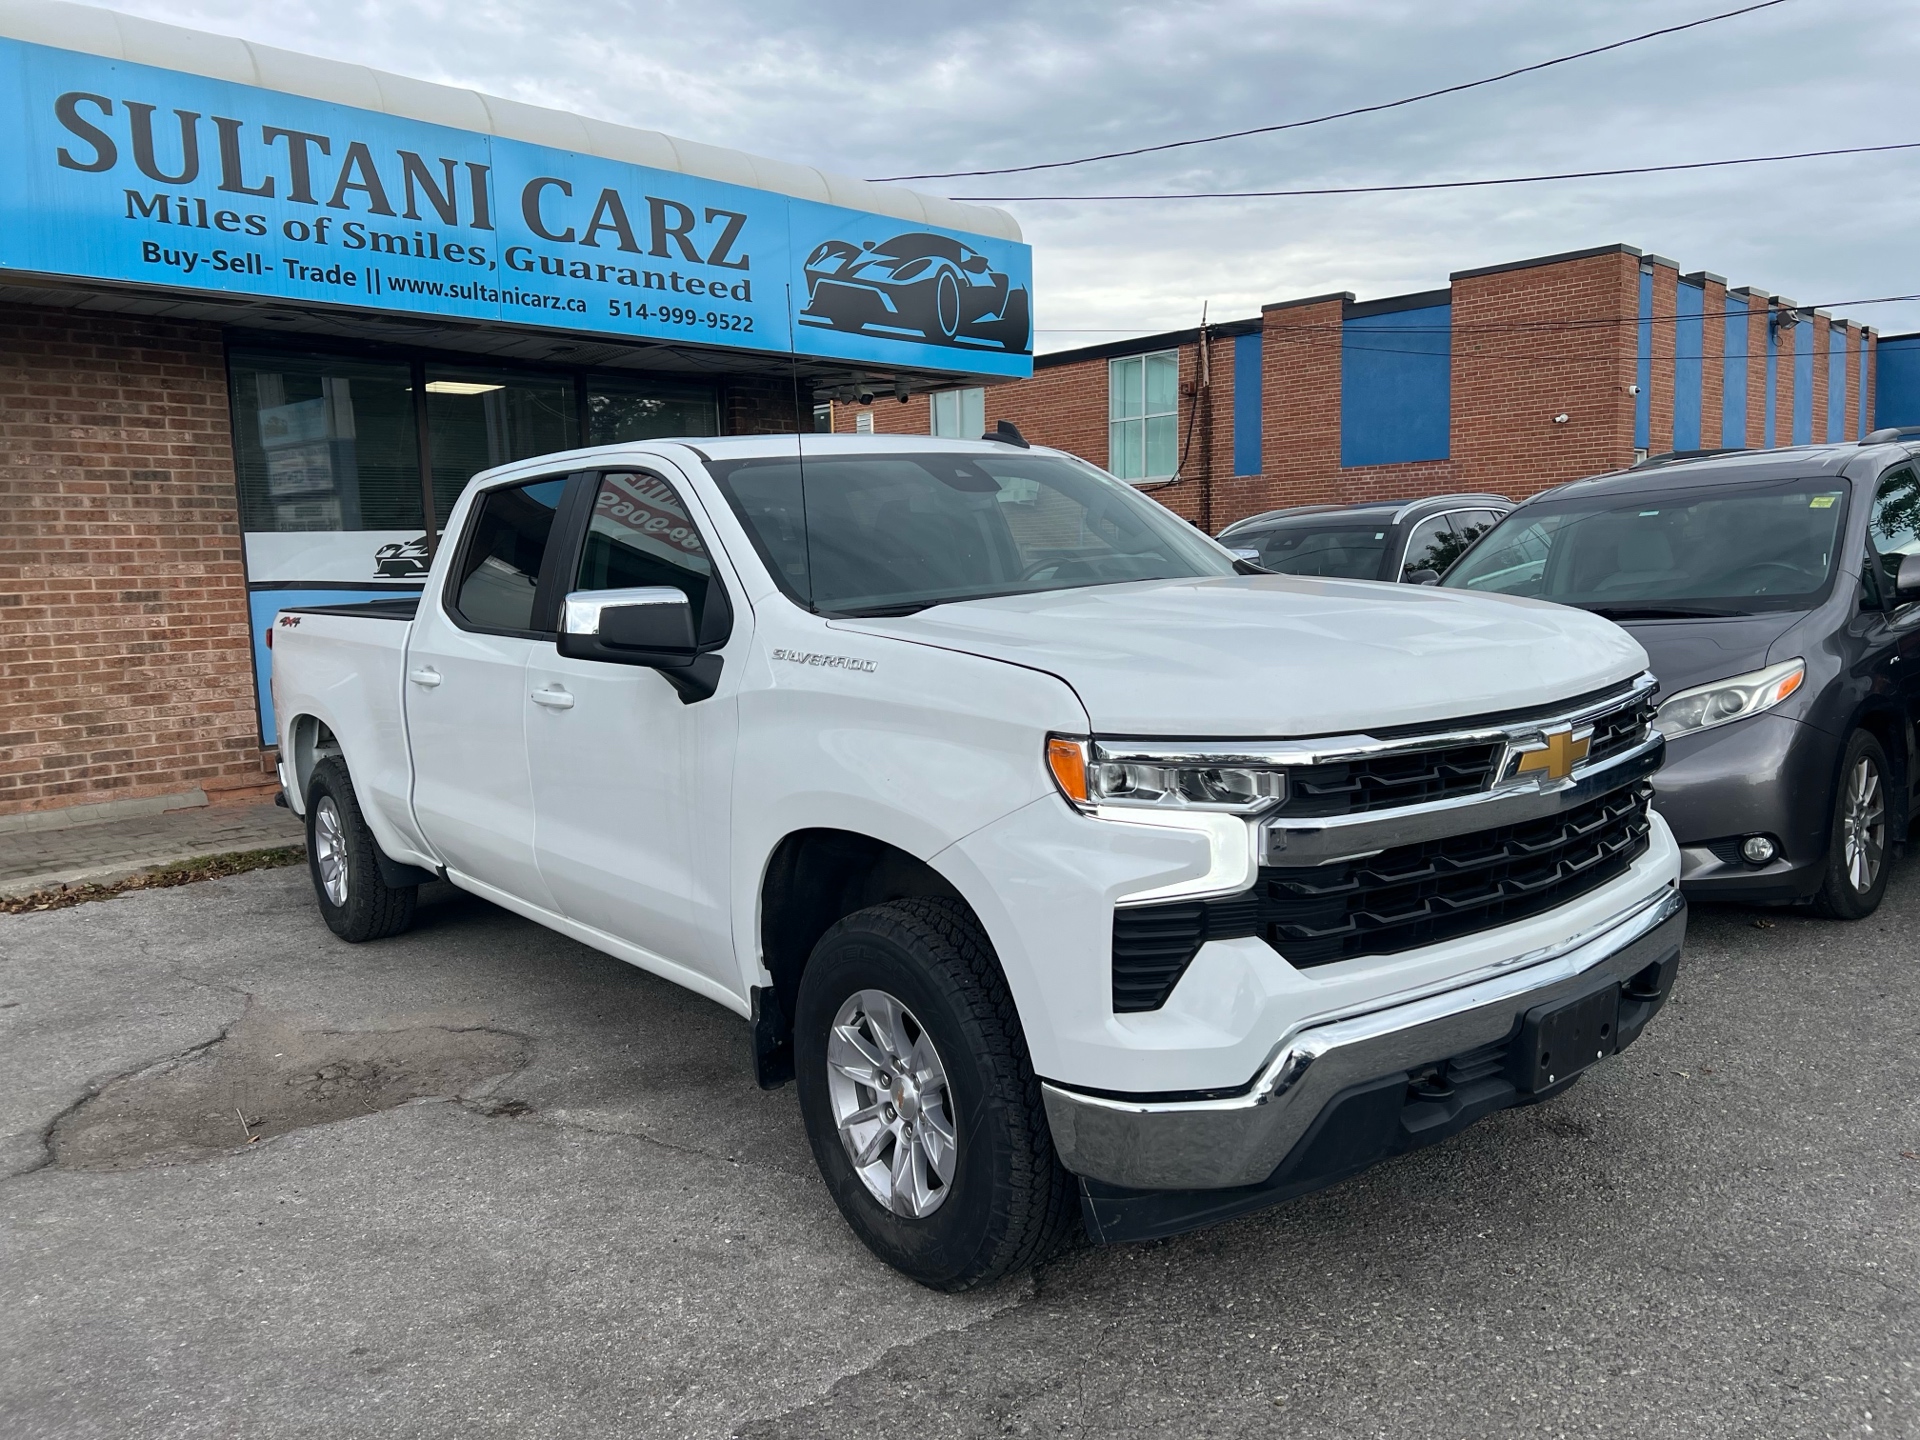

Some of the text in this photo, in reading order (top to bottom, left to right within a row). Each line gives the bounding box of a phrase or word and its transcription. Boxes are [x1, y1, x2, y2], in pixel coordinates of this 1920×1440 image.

[54, 91, 751, 271] SULTANI CARZ
[122, 188, 753, 303] Miles of Smiles, Guaranteed
[282, 257, 357, 287] Trade
[387, 275, 587, 313] www.sultanicarz.ca
[608, 299, 754, 333] 514-999-9522
[772, 648, 878, 673] SILVERADO
